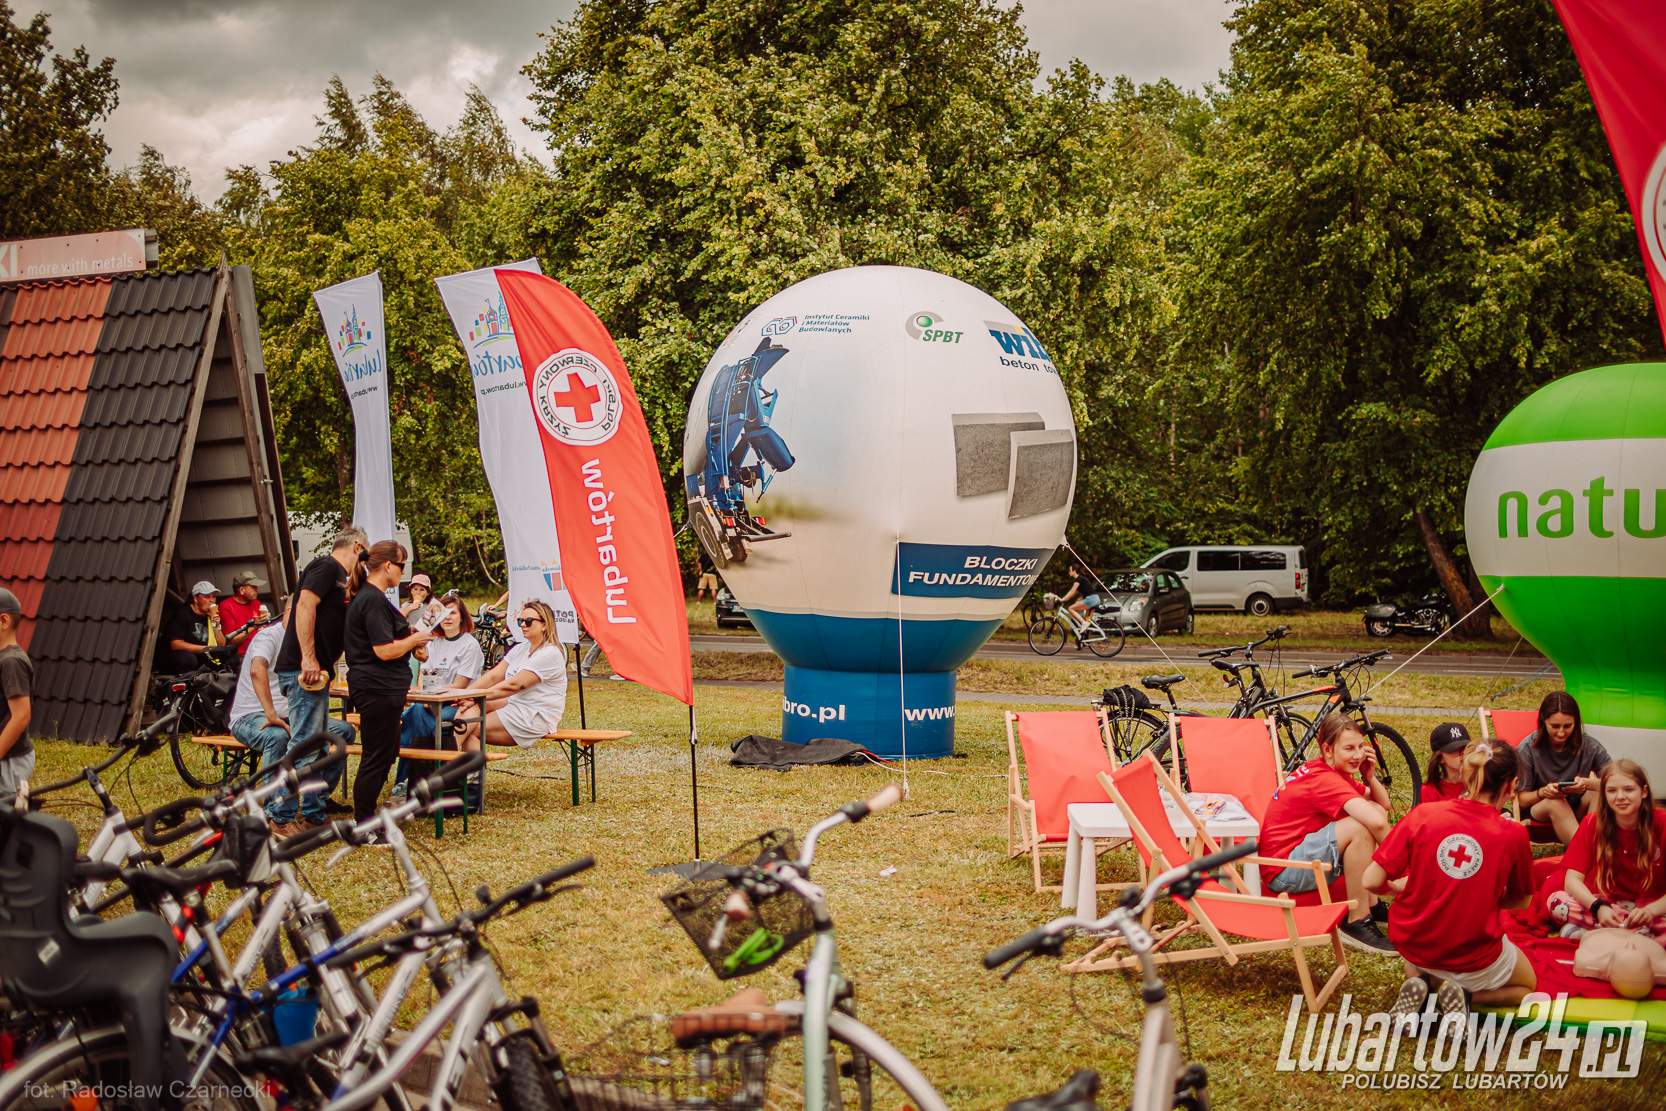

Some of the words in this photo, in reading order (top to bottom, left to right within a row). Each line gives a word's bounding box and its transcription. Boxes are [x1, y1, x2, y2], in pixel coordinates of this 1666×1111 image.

[27, 263, 59, 276] more
[61, 257, 88, 273] with
[92, 253, 134, 270] metals
[798, 326, 852, 334] Budowlanych
[922, 329, 964, 344] SPBT
[999, 355, 1039, 371] beton
[1497, 476, 1666, 539] natu
[964, 556, 1038, 571] BLOCZKI
